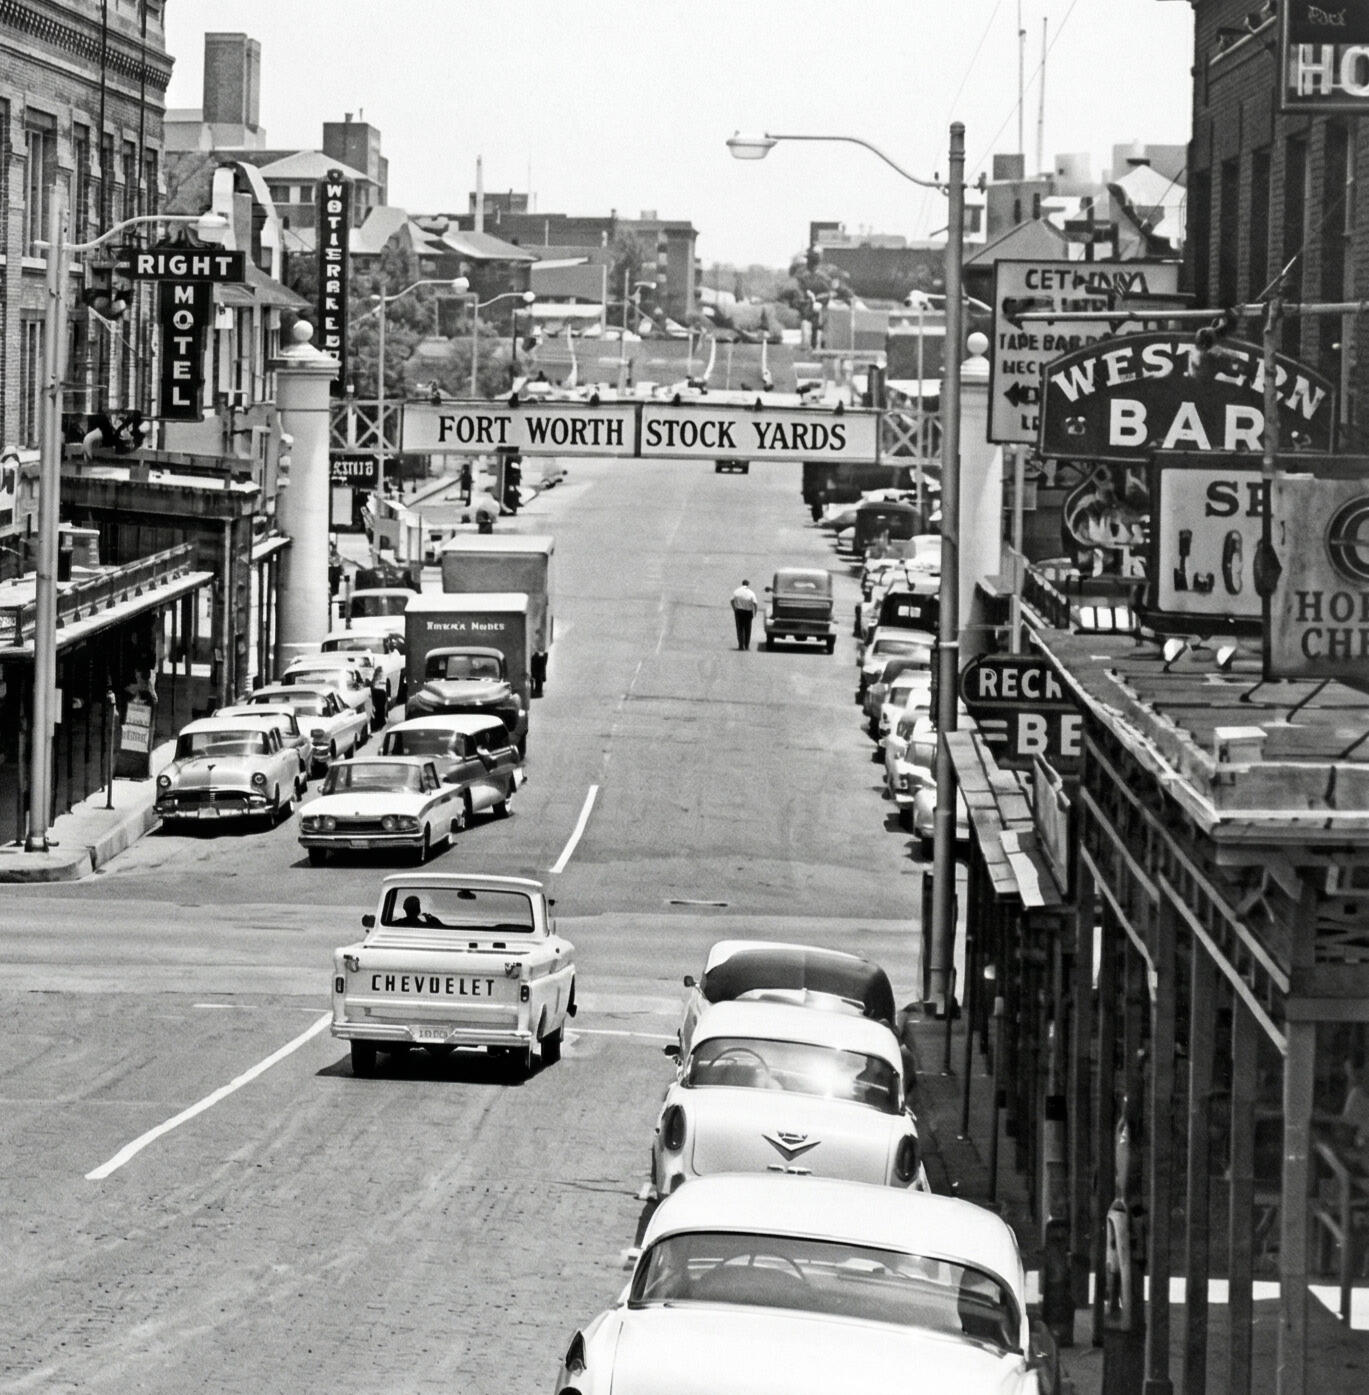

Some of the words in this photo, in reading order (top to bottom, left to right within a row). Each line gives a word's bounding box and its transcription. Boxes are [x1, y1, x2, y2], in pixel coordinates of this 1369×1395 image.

[137, 254, 233, 276] RIGHT
[172, 285, 194, 406] MOTEL
[1050, 342, 1326, 420] WESTERN
[439, 415, 512, 445] FORT
[526, 417, 624, 446] WORTH
[646, 419, 737, 449] STOCK
[752, 422, 847, 451] YARDS
[1108, 398, 1266, 451] BAR
